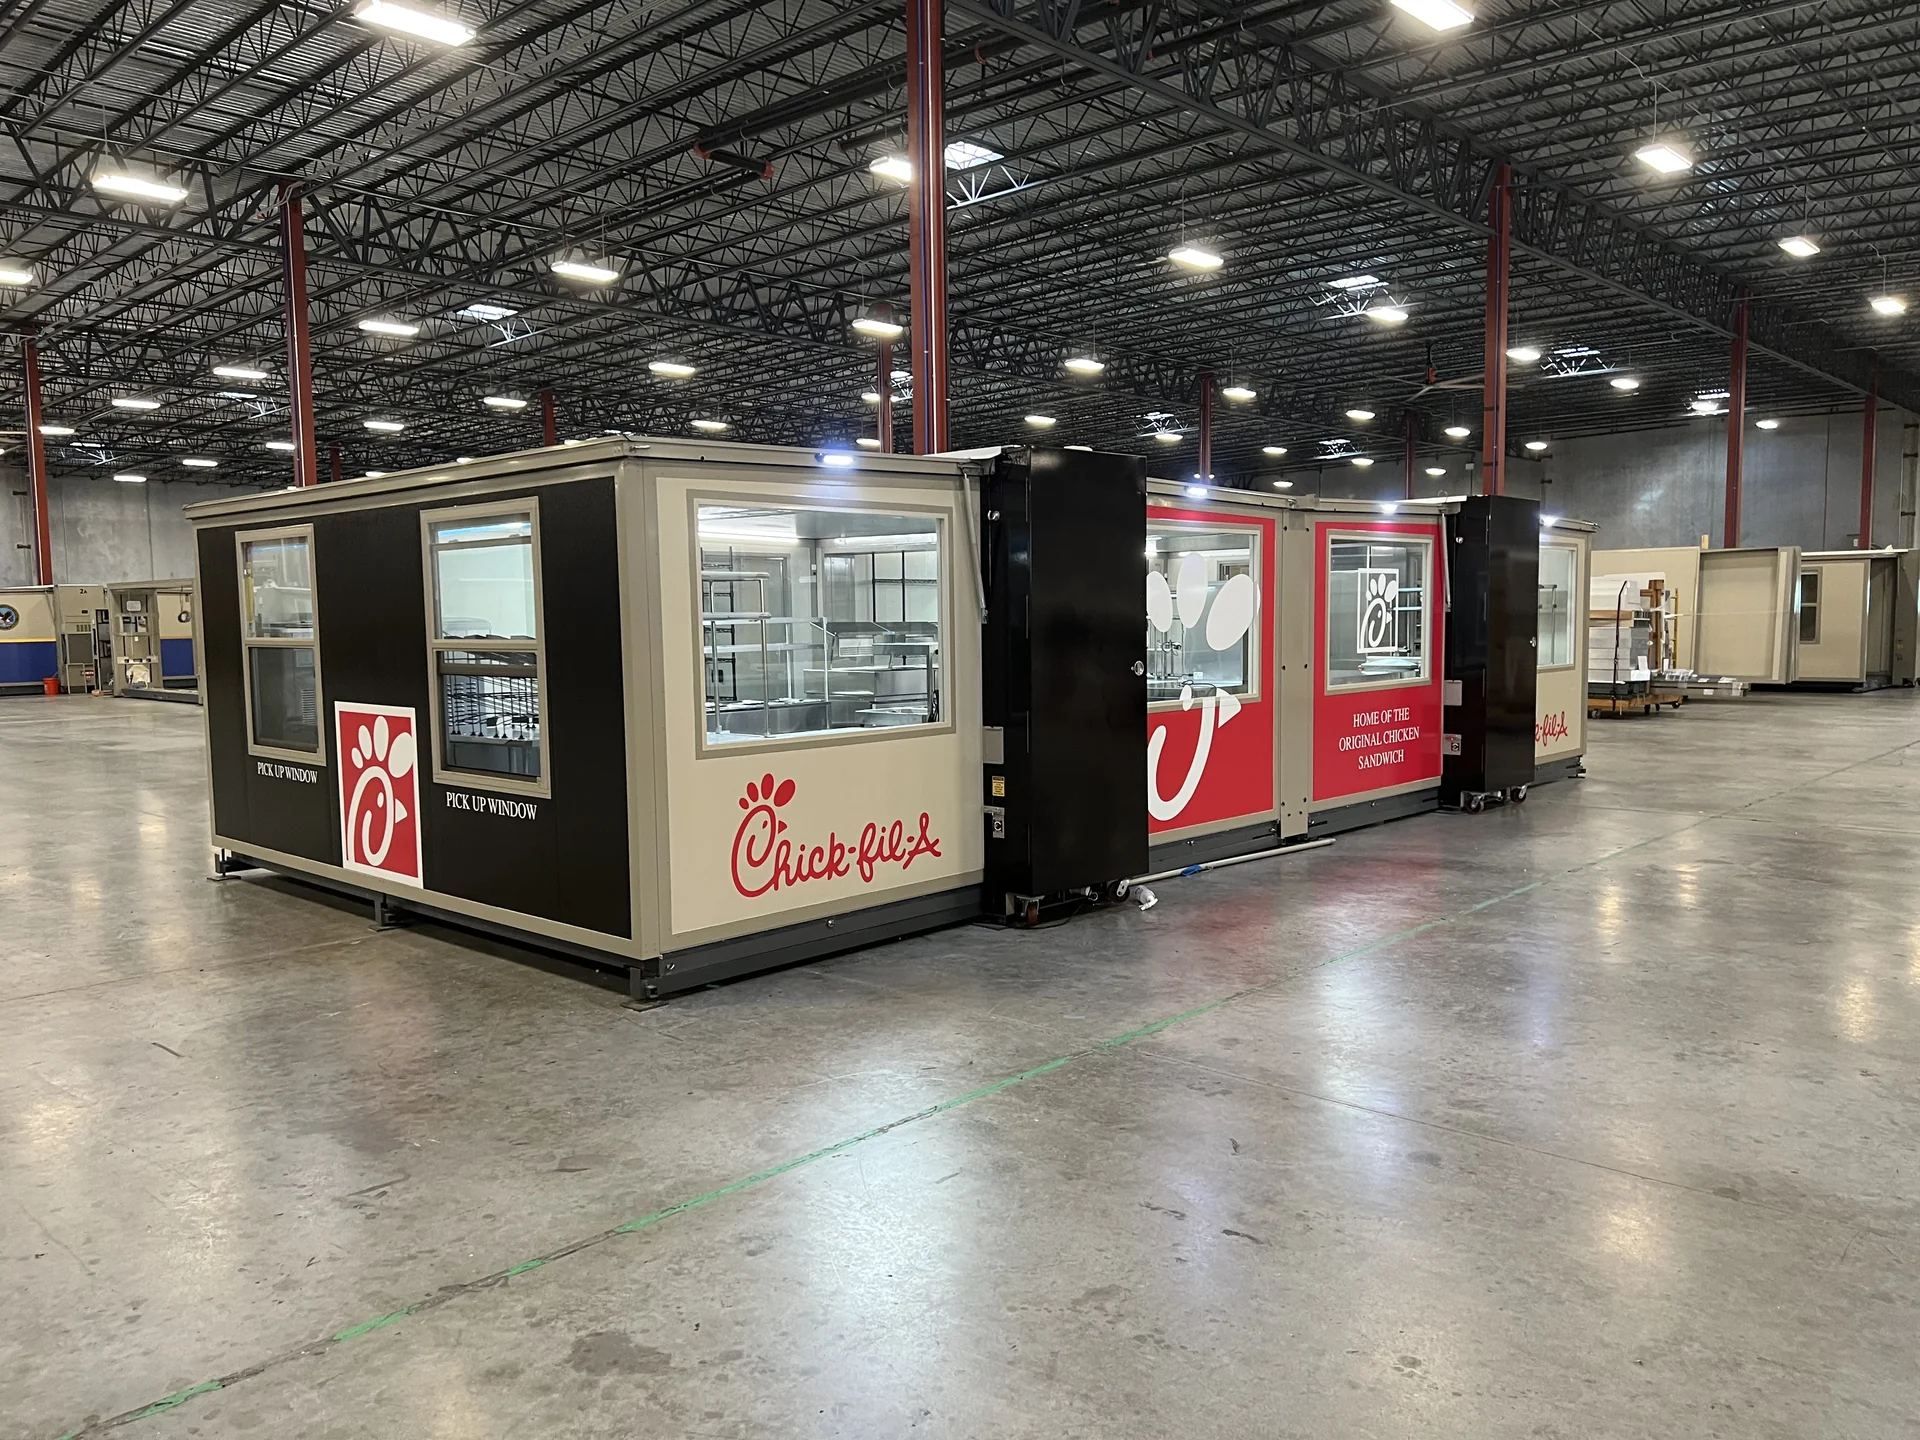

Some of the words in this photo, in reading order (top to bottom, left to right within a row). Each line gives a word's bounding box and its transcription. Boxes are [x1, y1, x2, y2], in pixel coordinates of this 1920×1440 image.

[1353, 711, 1379, 728] HOME
[1381, 709, 1392, 724] OF
[1393, 707, 1410, 722] THE
[1339, 732, 1382, 751] ORIGINAL
[1383, 726, 1420, 744] CHICKEN
[1358, 749, 1404, 770] SANDWICH
[257, 762, 274, 778] PICK
[274, 765, 285, 779] UP
[285, 767, 318, 784] WINDOW
[446, 792, 470, 811] PICK
[472, 796, 487, 813] UP
[488, 798, 538, 821] WINDOW
[731, 803, 942, 898] Chick-fil-A
